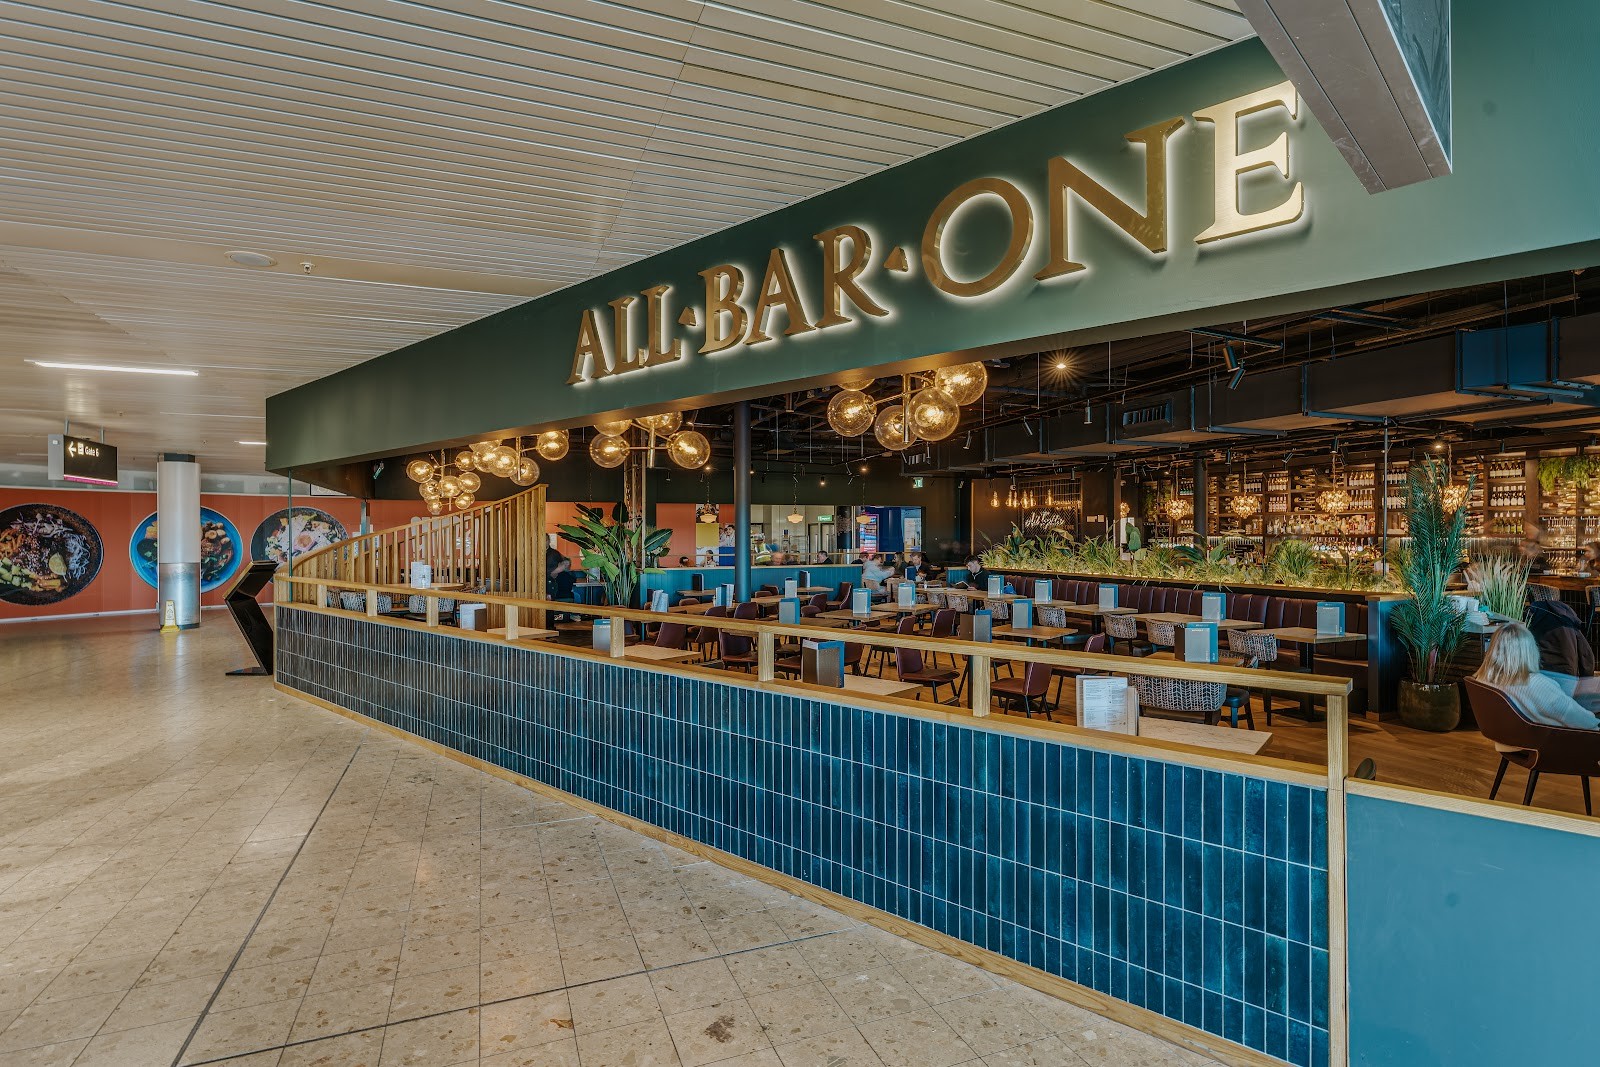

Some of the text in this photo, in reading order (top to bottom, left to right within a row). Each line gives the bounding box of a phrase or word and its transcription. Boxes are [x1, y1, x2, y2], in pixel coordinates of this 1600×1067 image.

[565, 79, 1305, 385] ALL BAR ONE
[84, 446, 96, 456] Gate
